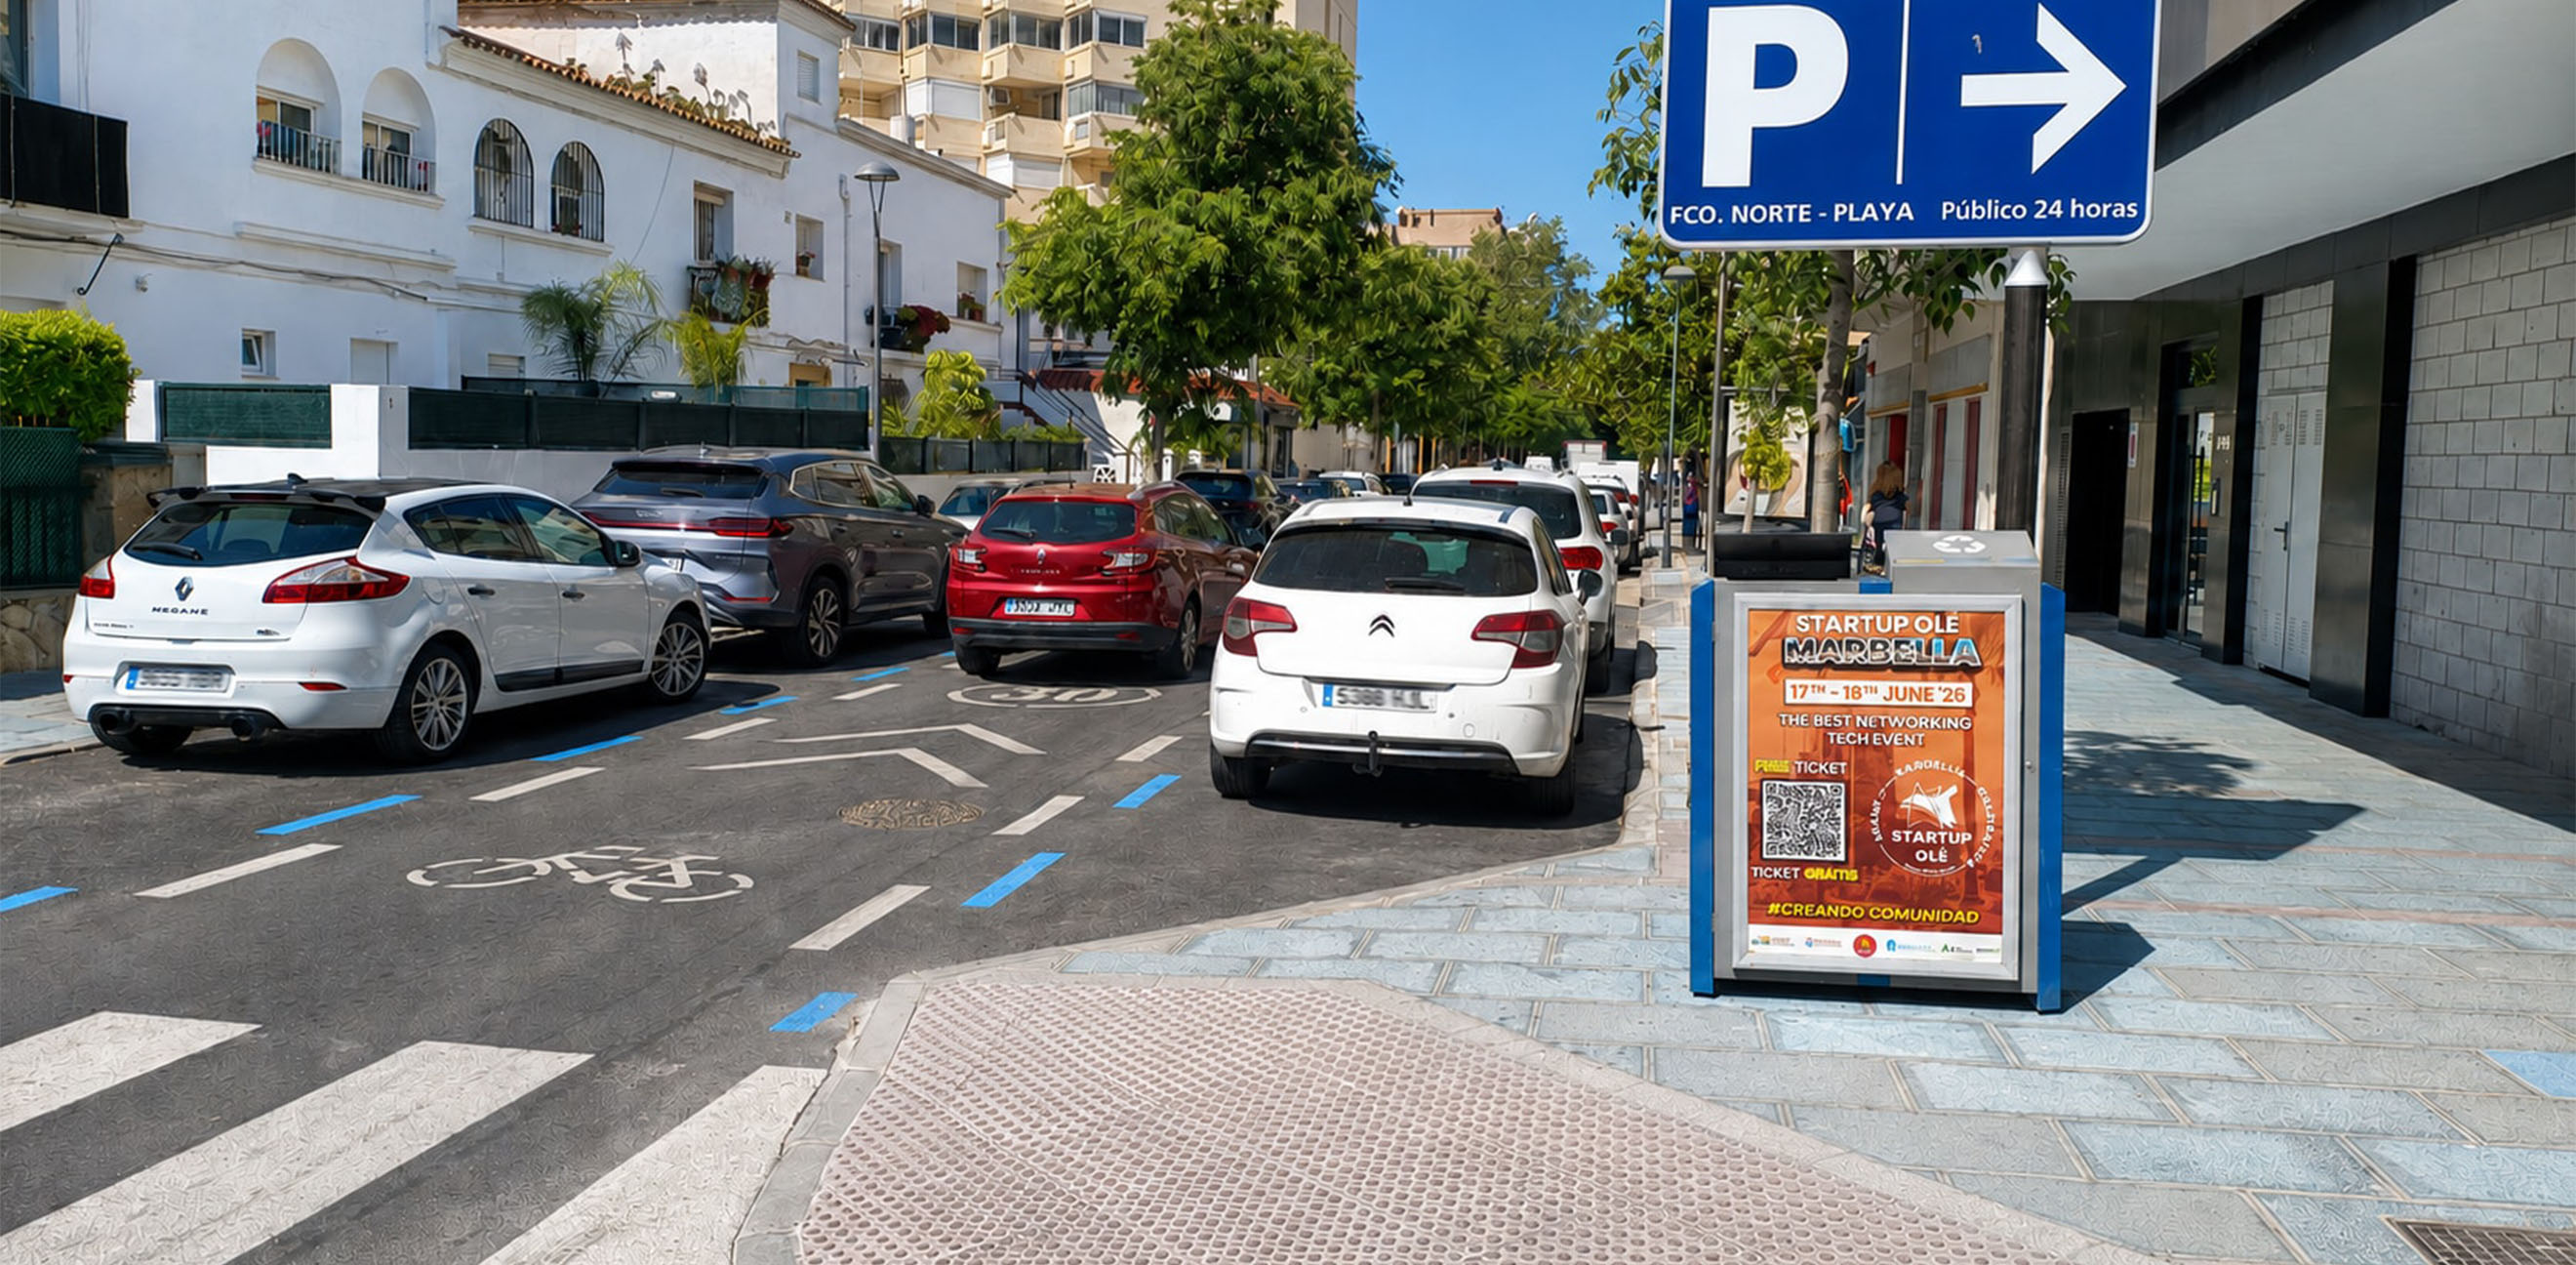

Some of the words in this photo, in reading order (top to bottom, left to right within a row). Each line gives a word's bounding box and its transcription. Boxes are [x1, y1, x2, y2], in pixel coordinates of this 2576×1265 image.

[1702, 4, 1849, 187] P
[1670, 205, 1724, 224] FCO.
[1731, 203, 1812, 224] NORTE
[1833, 202, 1914, 223] PLAYA
[1941, 198, 2027, 221] Público
[2033, 199, 2064, 219] 24
[2070, 197, 2139, 219] horas
[1796, 615, 1910, 632] STARTUP
[1784, 636, 1983, 667] MARBELLA
[990, 686, 1119, 702] 30
[1883, 686, 1935, 703] JUNE
[1779, 714, 1810, 727] THE
[1813, 714, 1853, 728] BEST
[1856, 714, 1973, 731] NETWORKING
[1828, 731, 1870, 746] TECH
[1872, 732, 1926, 747] EVENT
[1794, 761, 1848, 776] TICKET
[1892, 831, 1973, 845] STARTUP
[1751, 867, 1805, 880] TICKET
[1767, 902, 1865, 919] #CREANDO
[1869, 905, 1981, 924] COMUNIDAD
